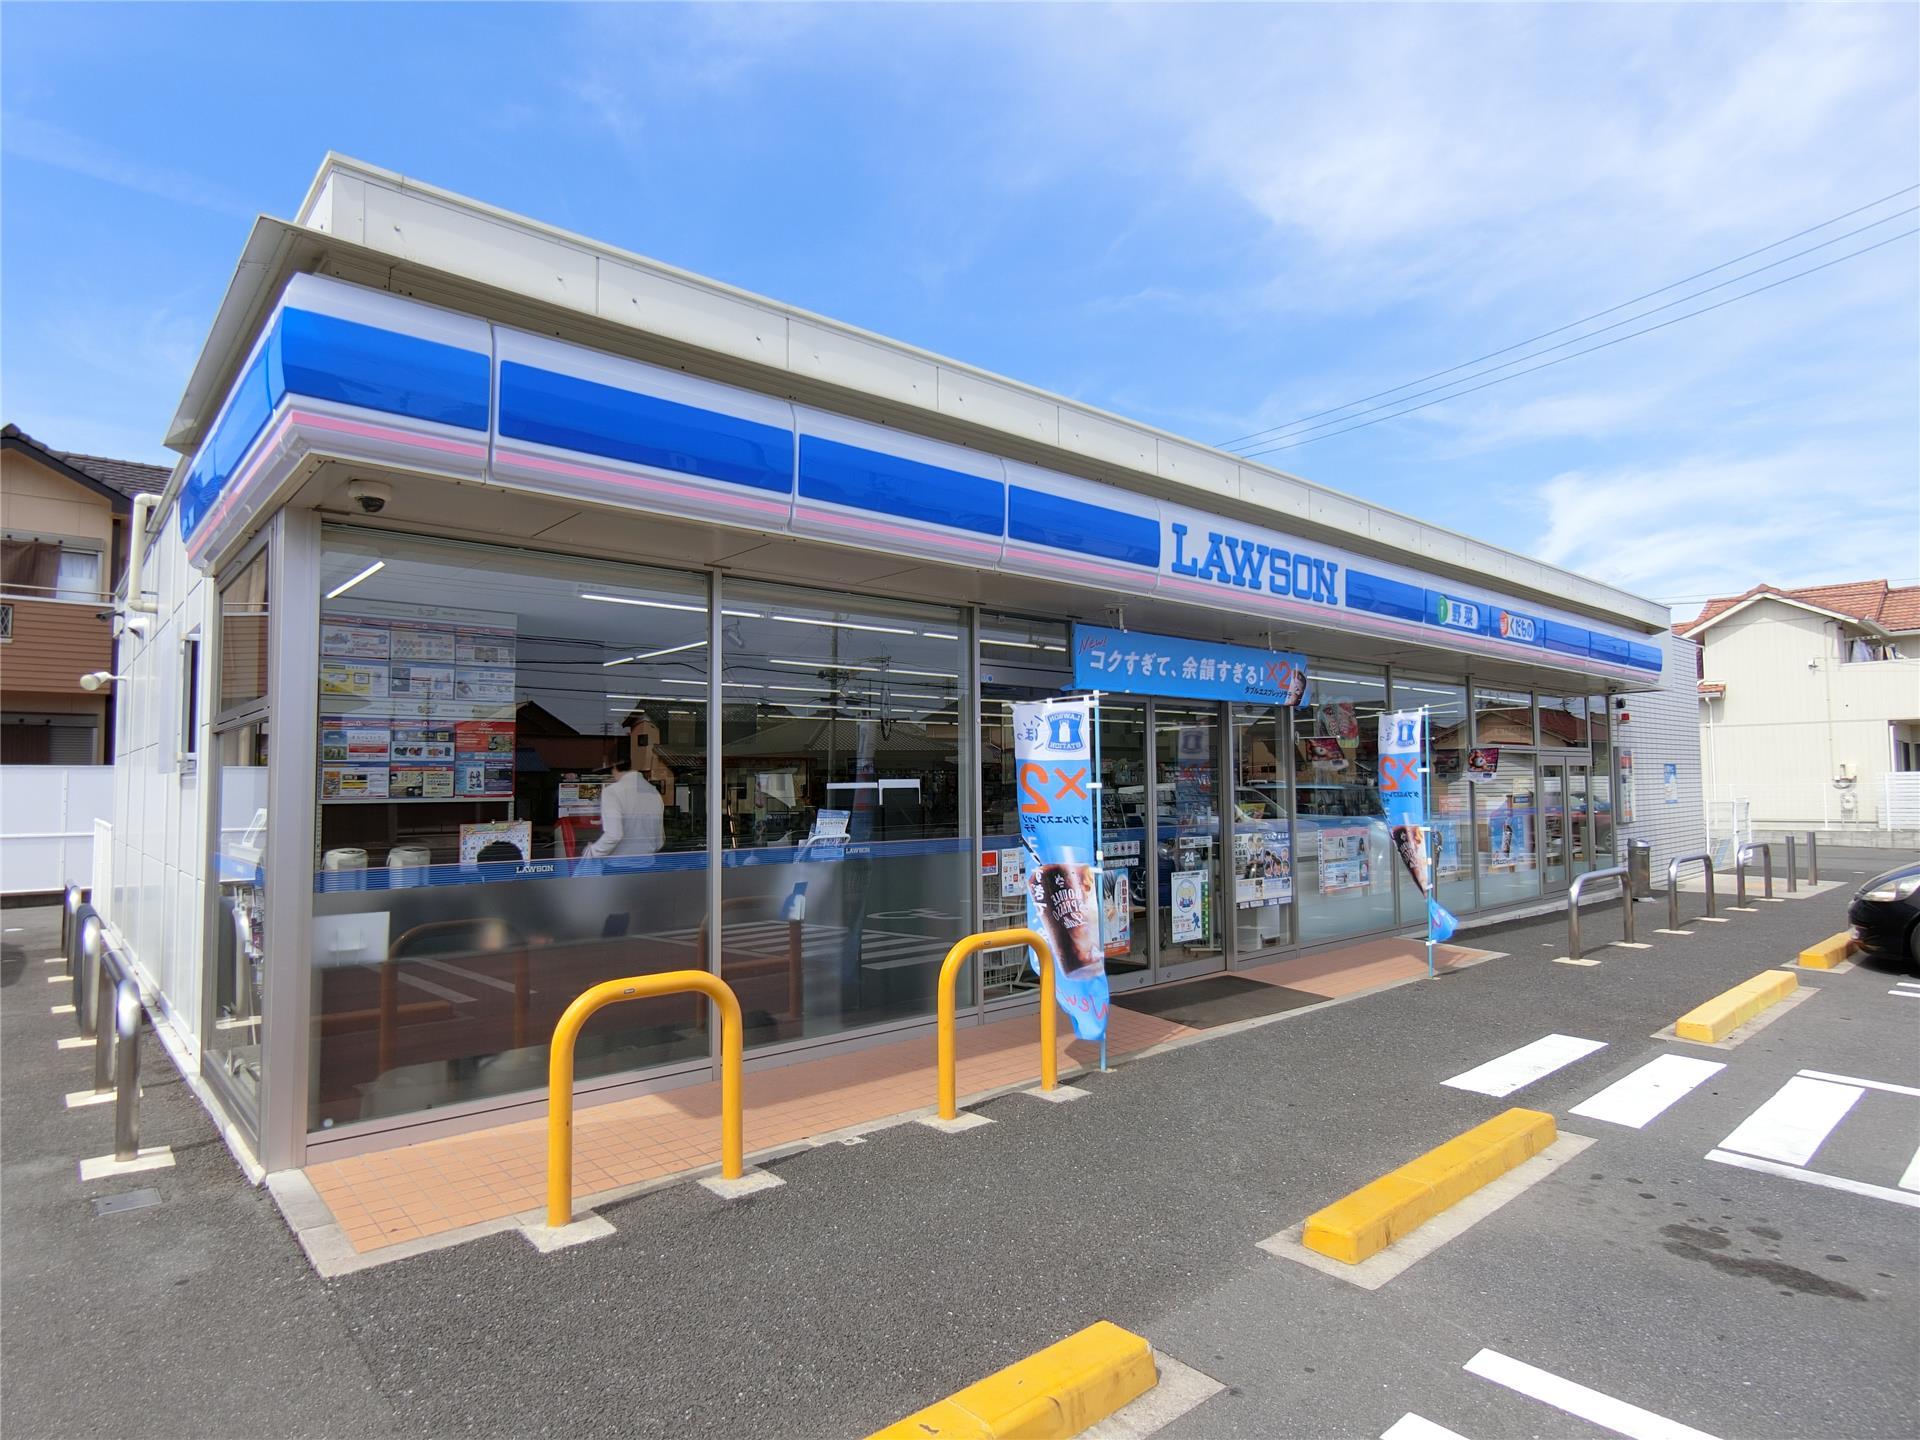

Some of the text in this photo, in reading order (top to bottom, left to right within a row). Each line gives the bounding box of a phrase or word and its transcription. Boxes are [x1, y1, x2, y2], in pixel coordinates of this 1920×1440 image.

[1172, 523, 1338, 605] LAWSON
[1510, 618, 1533, 638] くだもの
[516, 864, 554, 873] LAWSON
